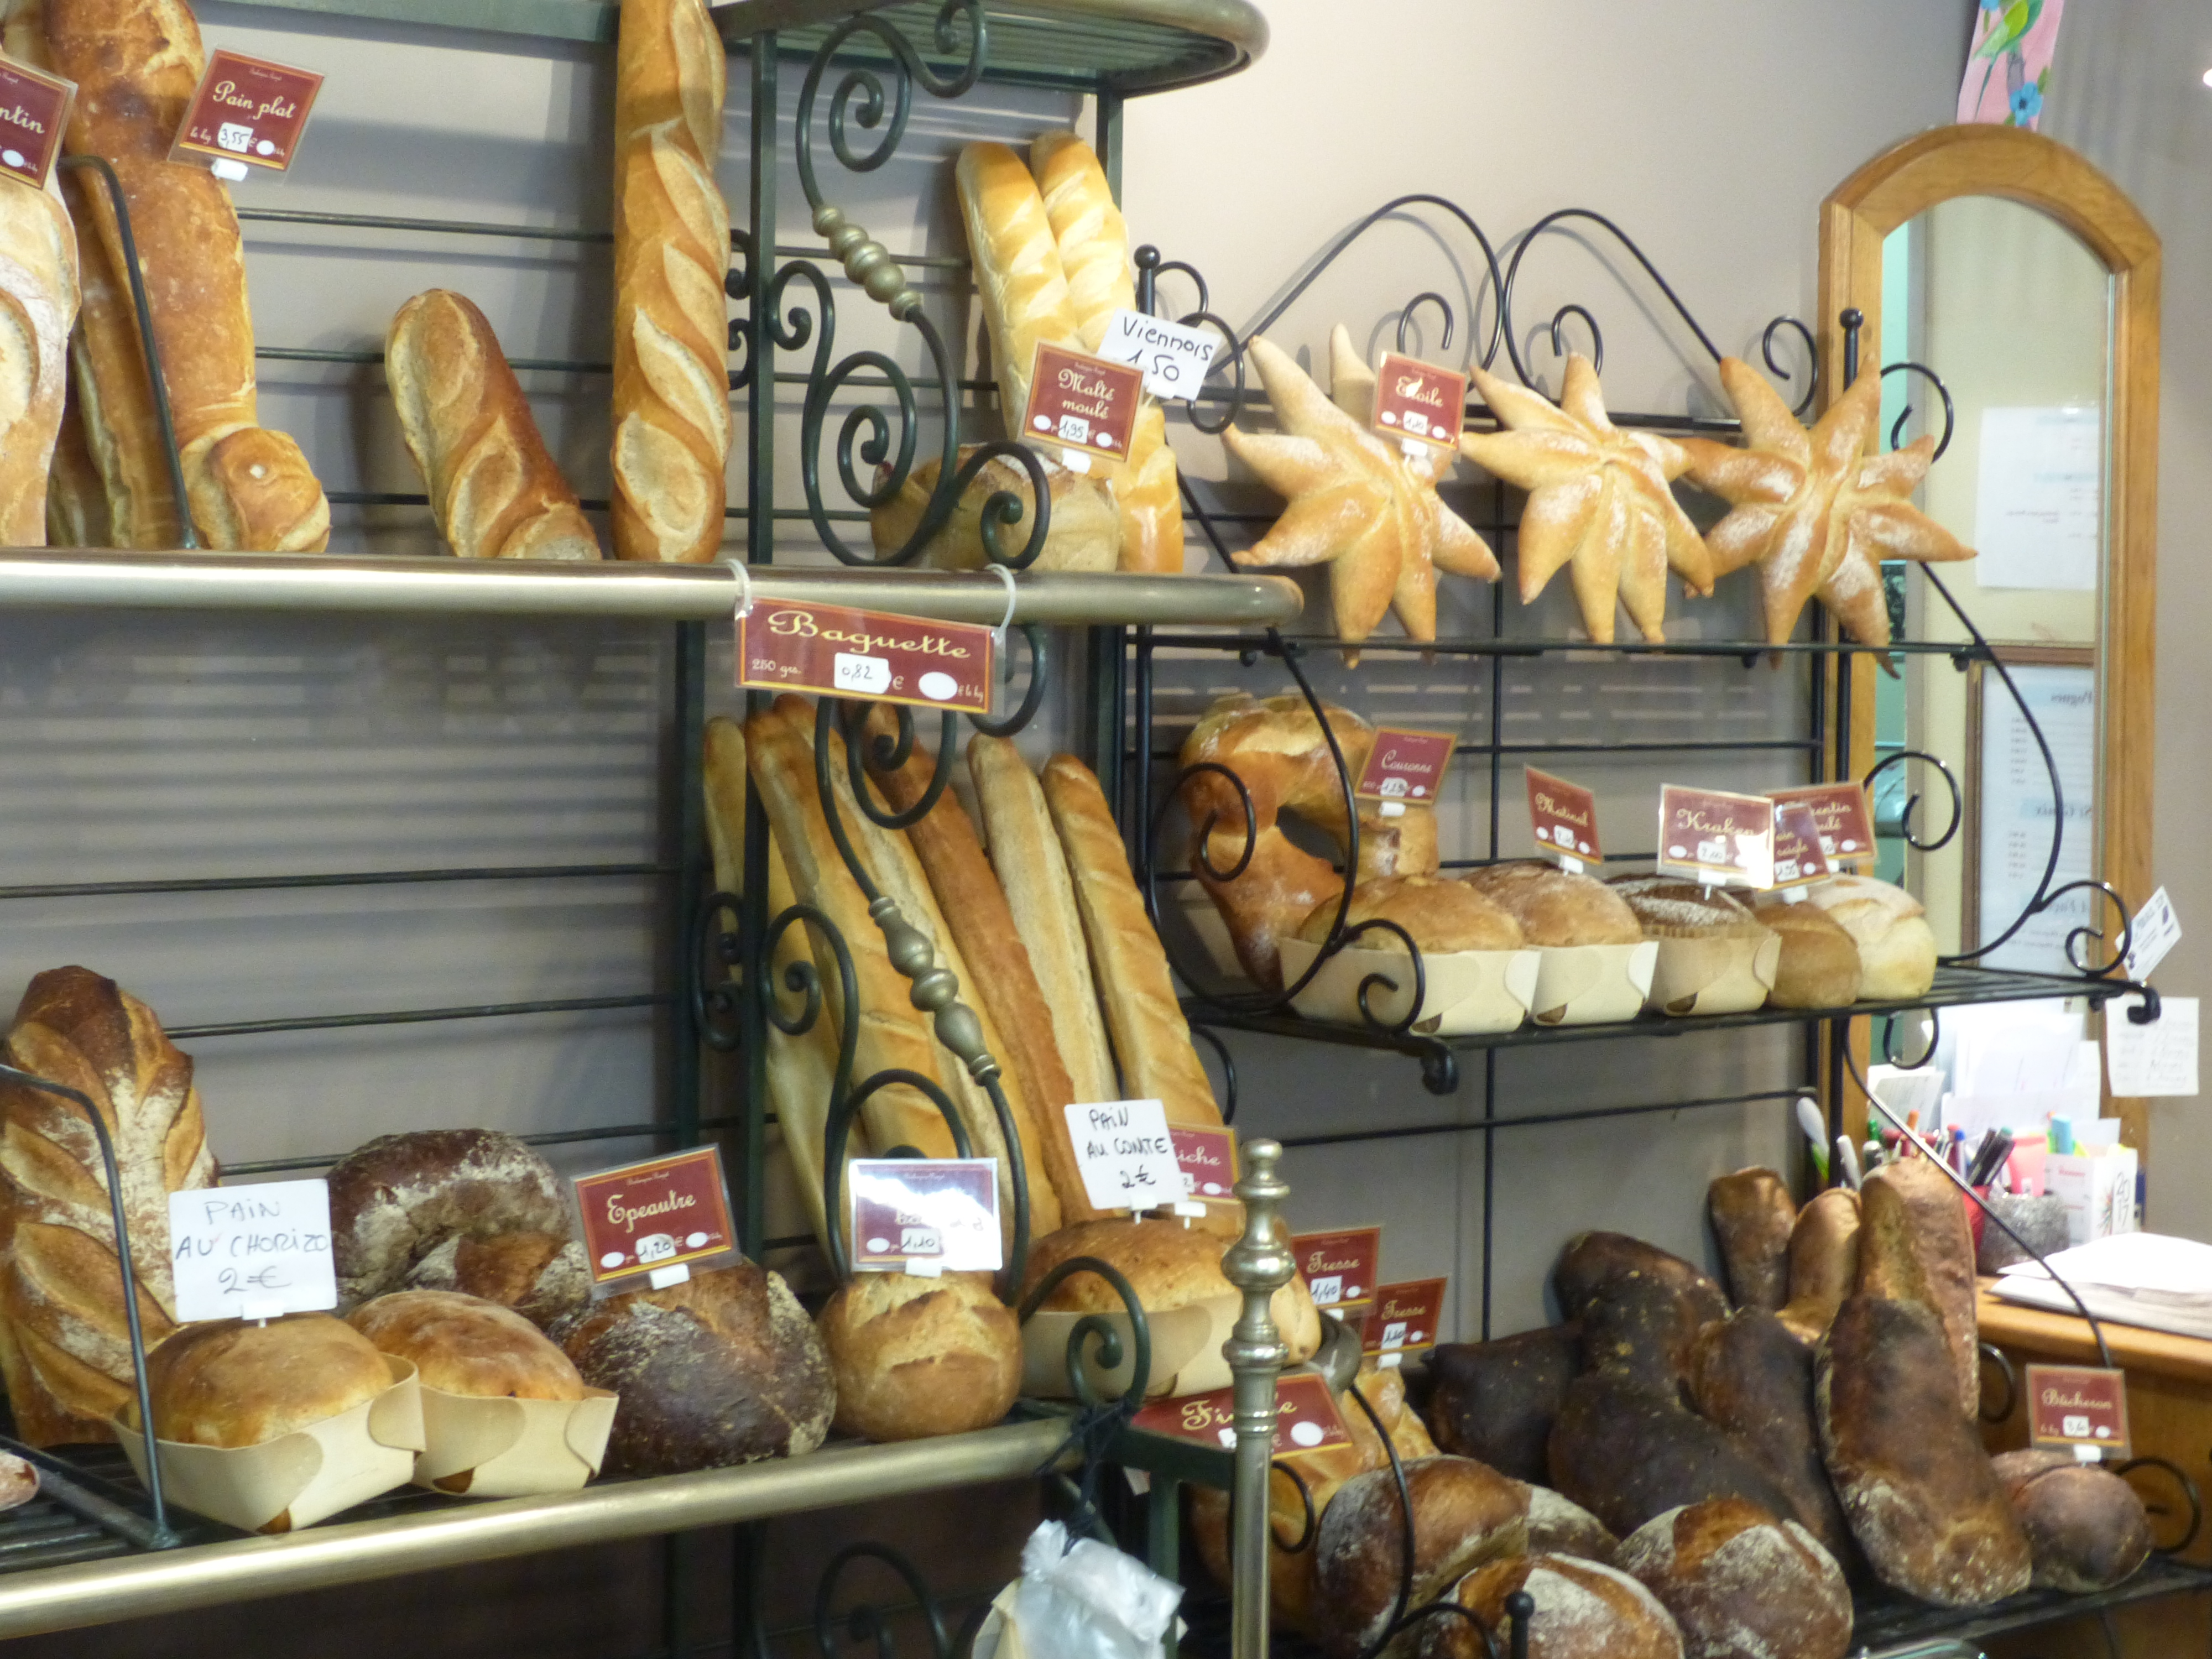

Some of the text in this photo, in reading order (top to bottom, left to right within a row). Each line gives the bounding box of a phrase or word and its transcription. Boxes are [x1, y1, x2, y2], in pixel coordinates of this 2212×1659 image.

[213, 80, 297, 121] Pain plat
[1123, 315, 1213, 362] Viennois
[1058, 368, 1115, 401] Malté
[1062, 399, 1110, 420] moulé
[768, 610, 971, 659] Baguette
[1381, 749, 1433, 774] Couronne
[1089, 1105, 1129, 1131] PAIN
[1087, 1140, 1109, 1159] AU
[1173, 1143, 1221, 1166] iche
[204, 1198, 280, 1225] PAIN
[607, 1190, 696, 1234] Epeautre
[175, 1228, 328, 1260] AU CHORIZO
